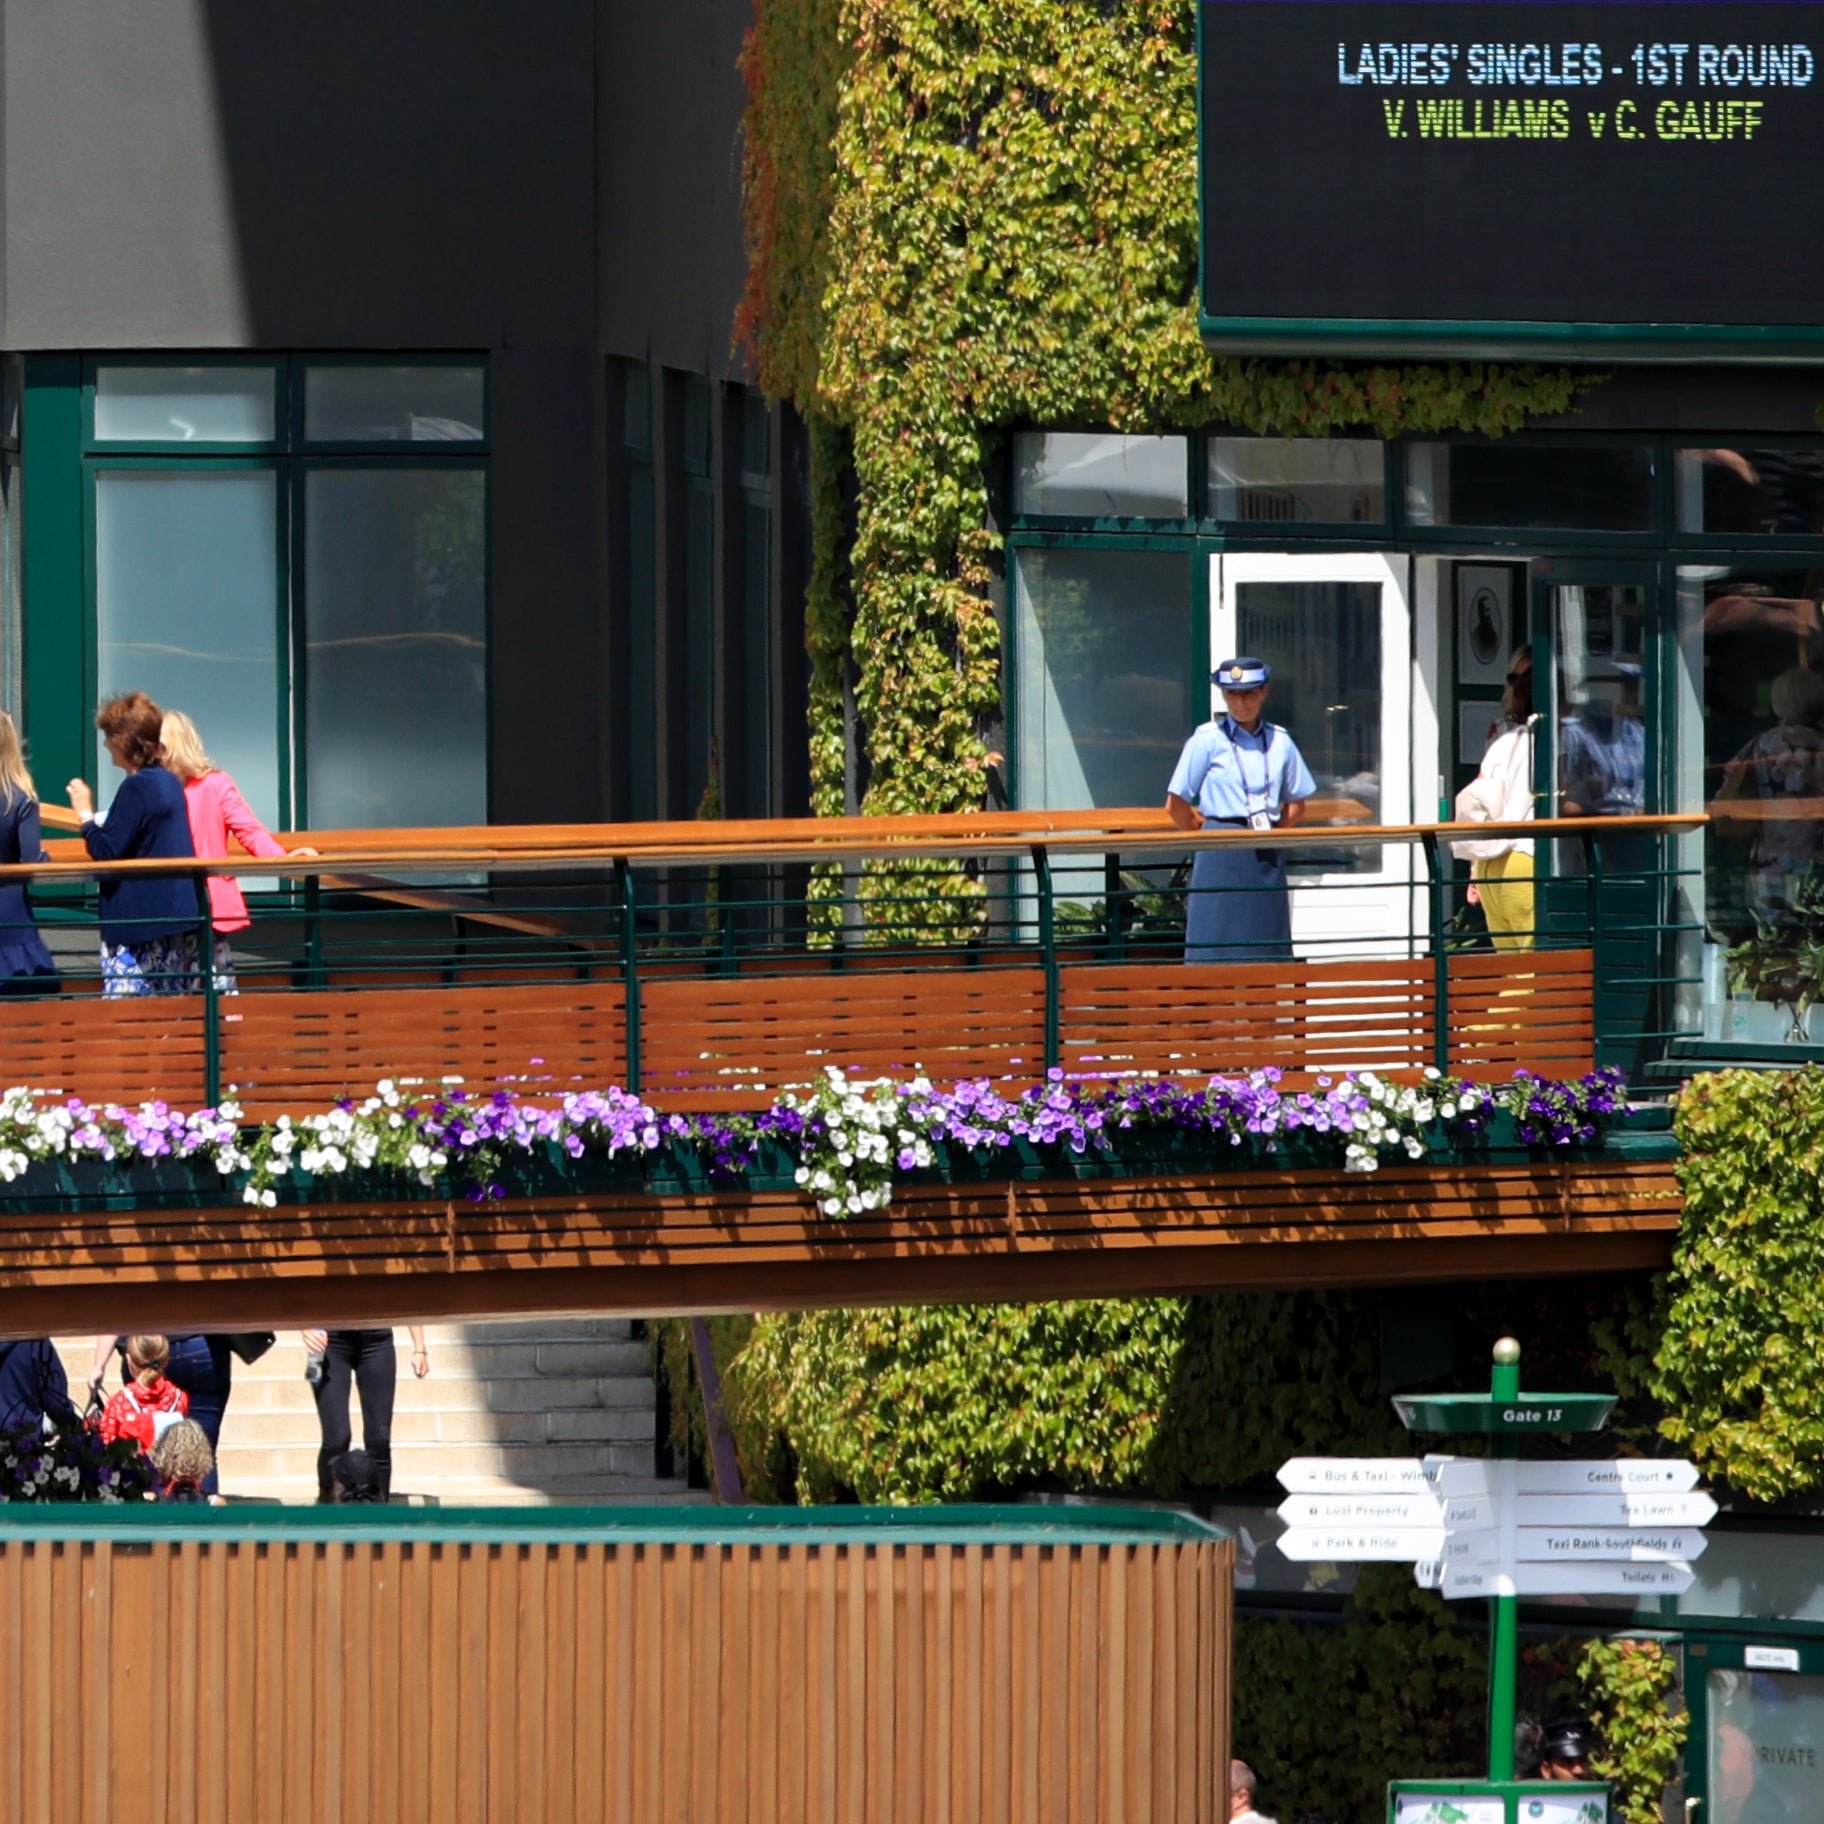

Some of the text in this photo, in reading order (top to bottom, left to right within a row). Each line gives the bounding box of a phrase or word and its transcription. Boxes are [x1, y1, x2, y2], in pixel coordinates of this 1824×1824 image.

[1338, 43, 1459, 85] LADIES'
[1466, 43, 1602, 85] SINGLES
[1631, 43, 1689, 86] 1ST
[1699, 44, 1815, 87] ROUND
[1383, 99, 1764, 140] V. WILLIAMS v C. GAUFF
[1503, 1408, 1563, 1423] Gate 13
[1325, 1471, 1347, 1482] Bus
[1351, 1471, 1360, 1482] &
[1364, 1471, 1388, 1482] Taxi
[1587, 1471, 1660, 1483] Centre Court
[1326, 1506, 1408, 1518] Lost Property
[1327, 1537, 1353, 1549] Park
[1370, 1537, 1398, 1549] Ride
[1546, 1538, 1570, 1549] Taxi
[1755, 1746, 1816, 1768] RIVATE
